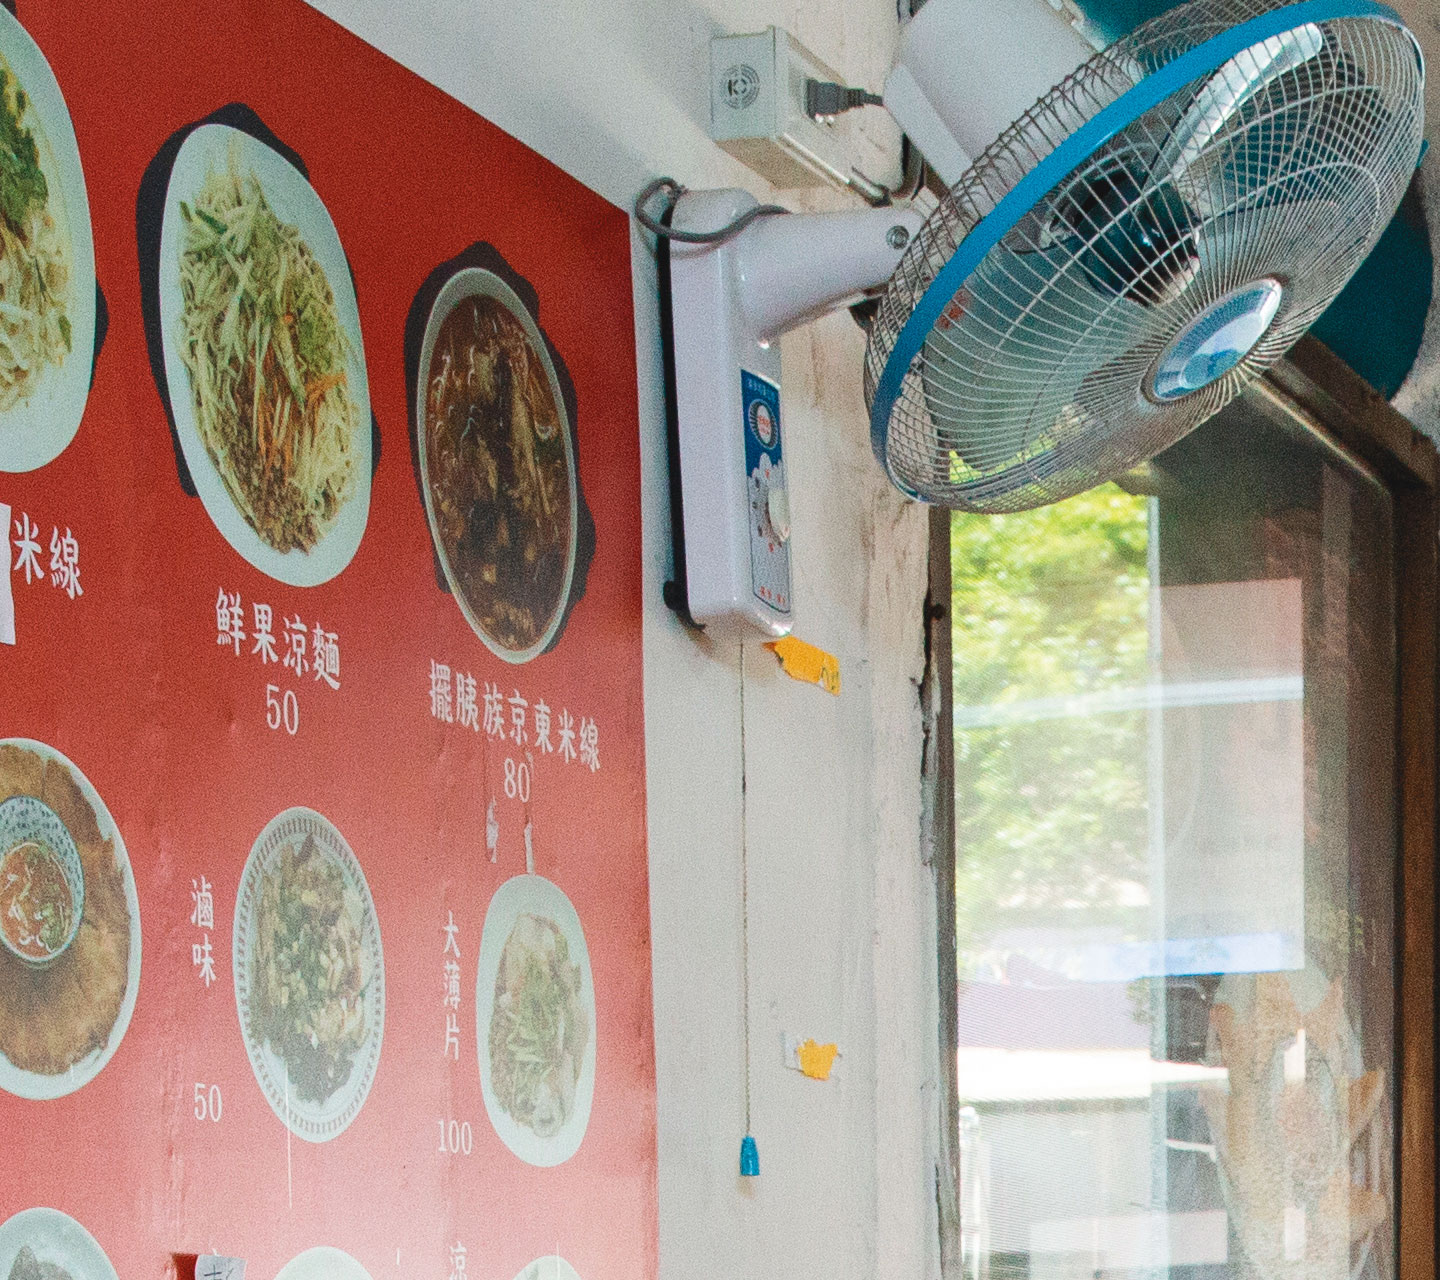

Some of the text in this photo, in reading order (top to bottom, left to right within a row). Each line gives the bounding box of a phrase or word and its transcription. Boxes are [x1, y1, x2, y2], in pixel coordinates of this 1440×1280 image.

[215, 586, 341, 692] 鮮果涼麵
[266, 684, 300, 737] 50
[503, 757, 531, 804] 80
[190, 874, 219, 988] 滷味
[443, 909, 462, 1061] 大薄片
[193, 1083, 223, 1123] 50
[437, 1118, 473, 1156] 100
